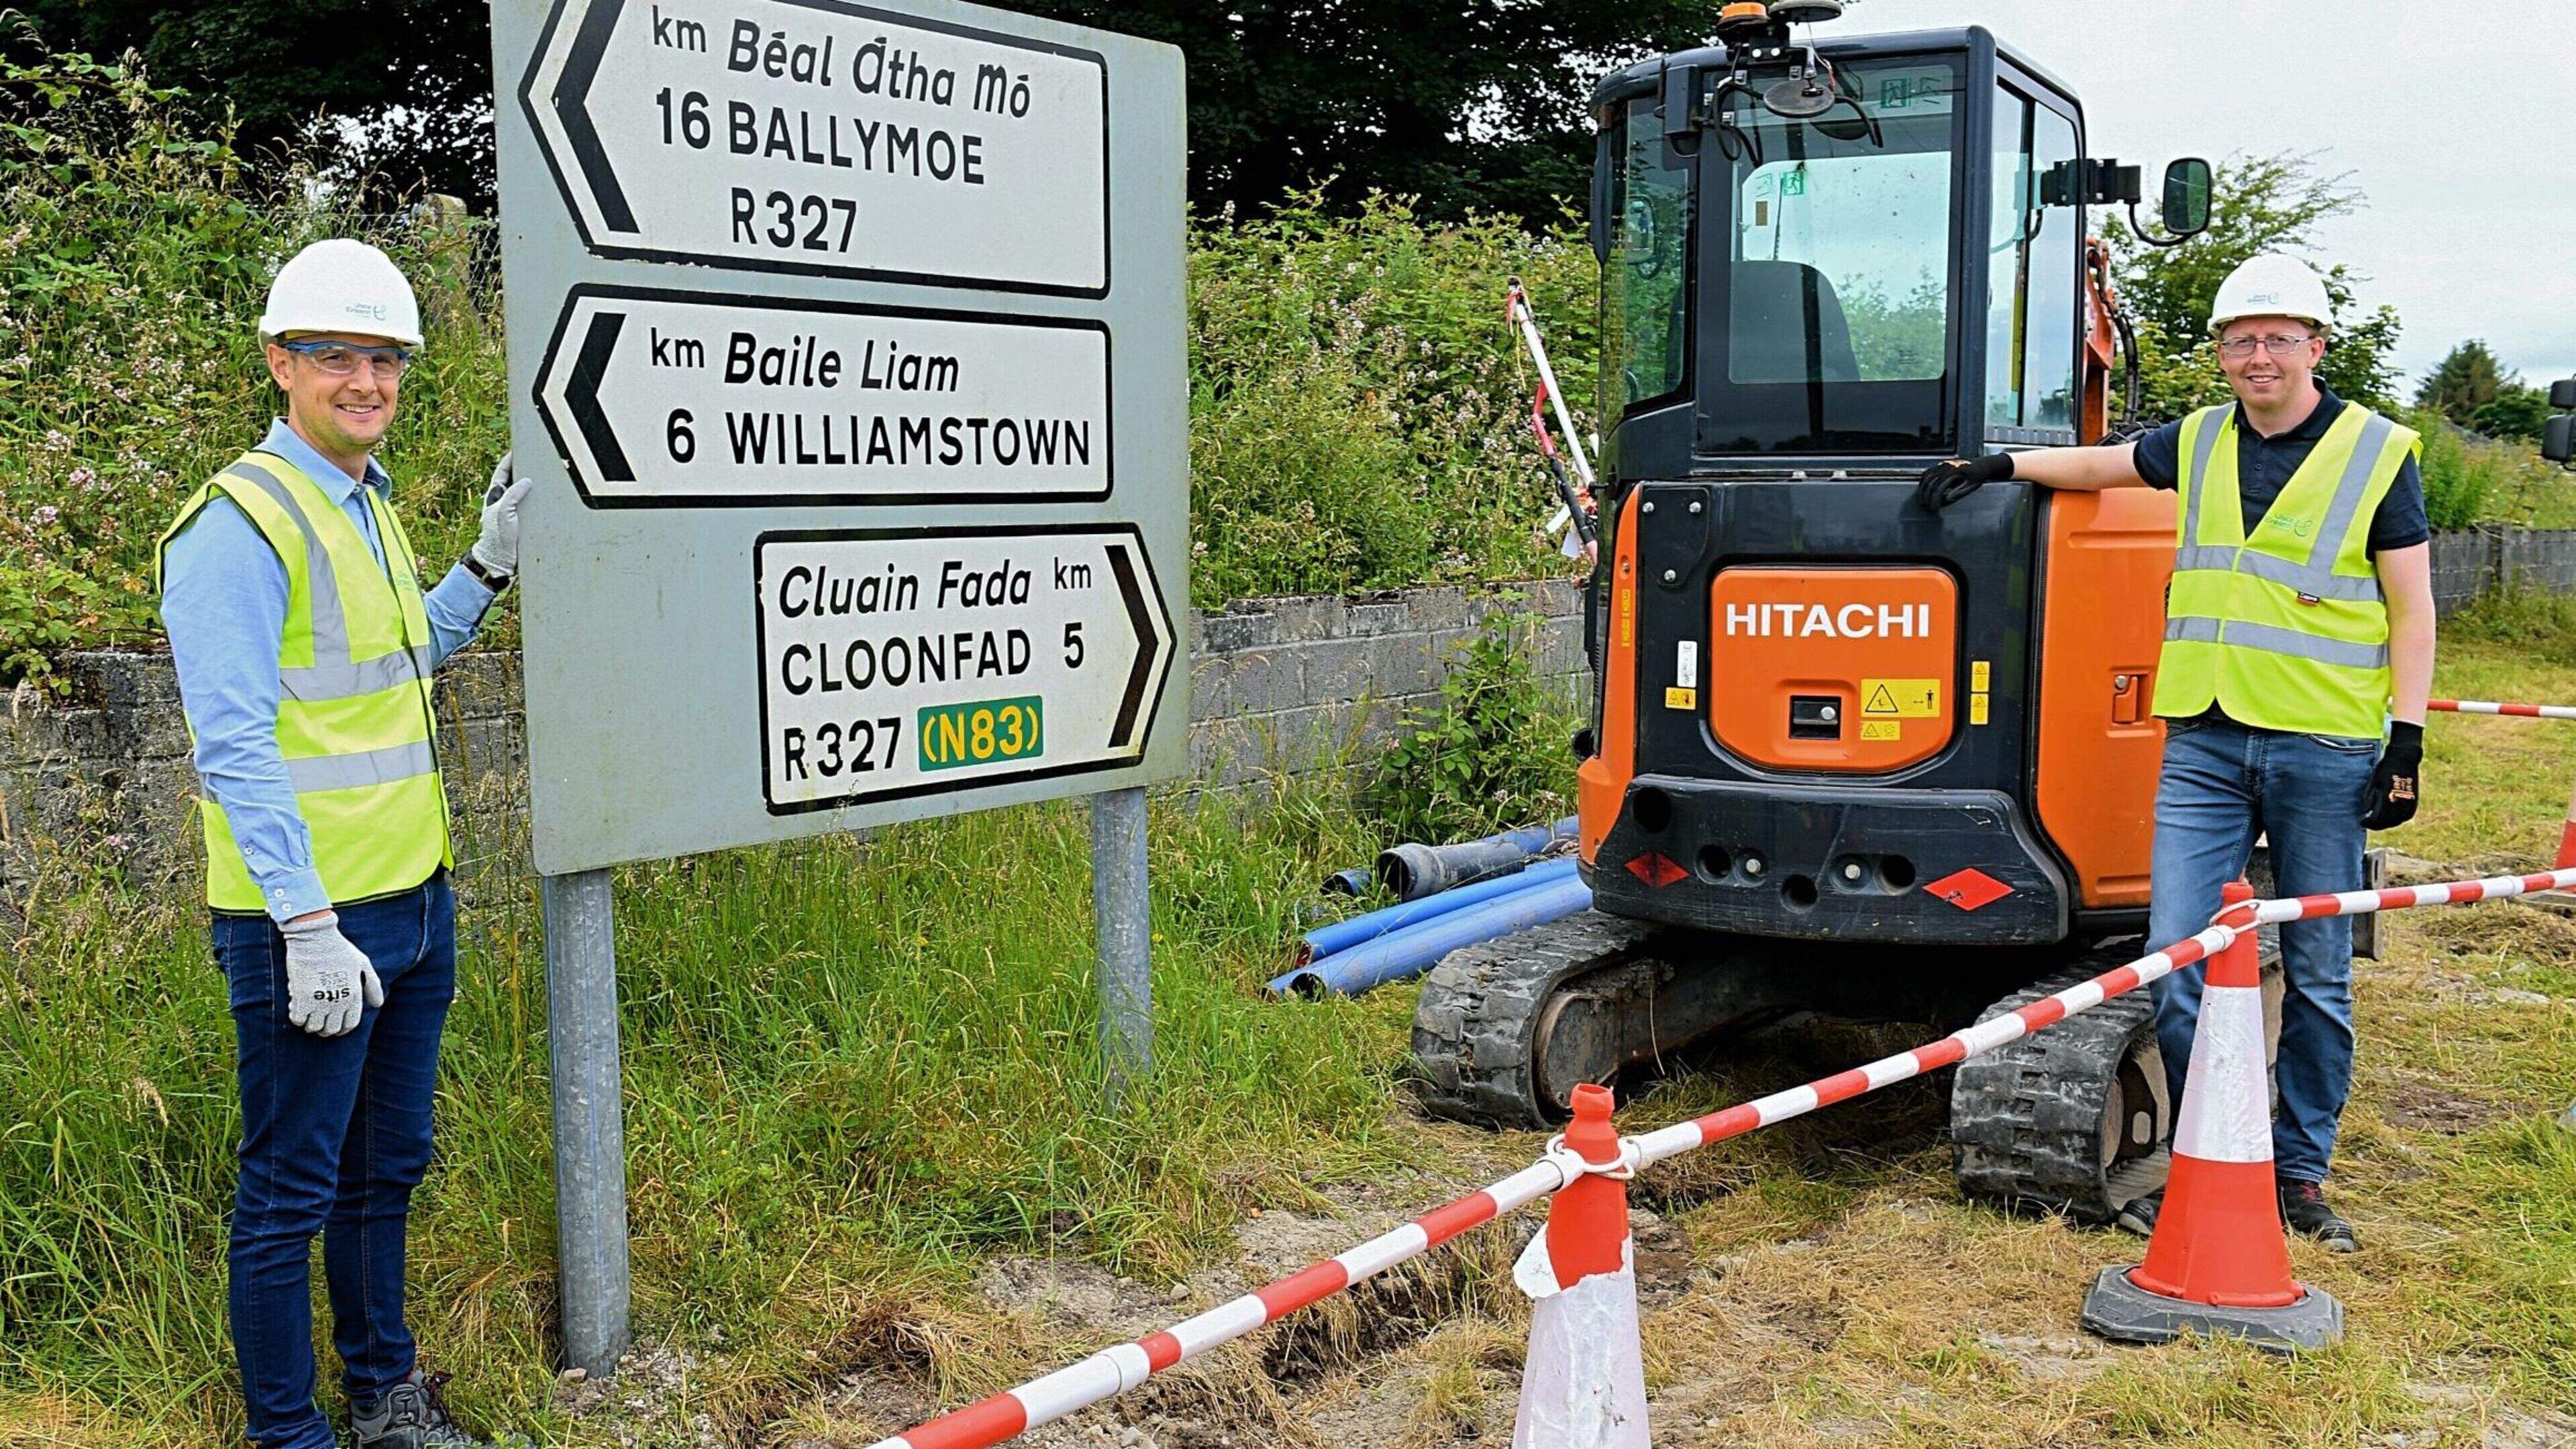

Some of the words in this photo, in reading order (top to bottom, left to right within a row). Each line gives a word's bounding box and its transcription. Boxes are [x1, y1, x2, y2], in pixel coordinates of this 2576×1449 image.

[652, 5, 707, 53] km
[727, 19, 833, 87] Béal
[853, 36, 955, 106] Átha
[973, 64, 1030, 118] Mó
[656, 87, 711, 150] 16
[728, 100, 984, 184] BALLYMOE
[731, 186, 857, 253] R327
[651, 327, 705, 368] km
[724, 331, 841, 388] Baile
[860, 339, 959, 392] Liam
[667, 408, 695, 464] 6
[725, 412, 1089, 466] WILLIAMSTOWN
[779, 562, 919, 619] Cluain
[937, 559, 1031, 608] Fada
[1054, 557, 1091, 590] km
[1727, 604, 1929, 638] HITACHI
[782, 629, 1031, 696] CLOONFAD
[1064, 622, 1084, 669] 5
[784, 716, 901, 782] R327
[923, 706, 1038, 763] (N83)
[313, 987, 350, 1003] site
